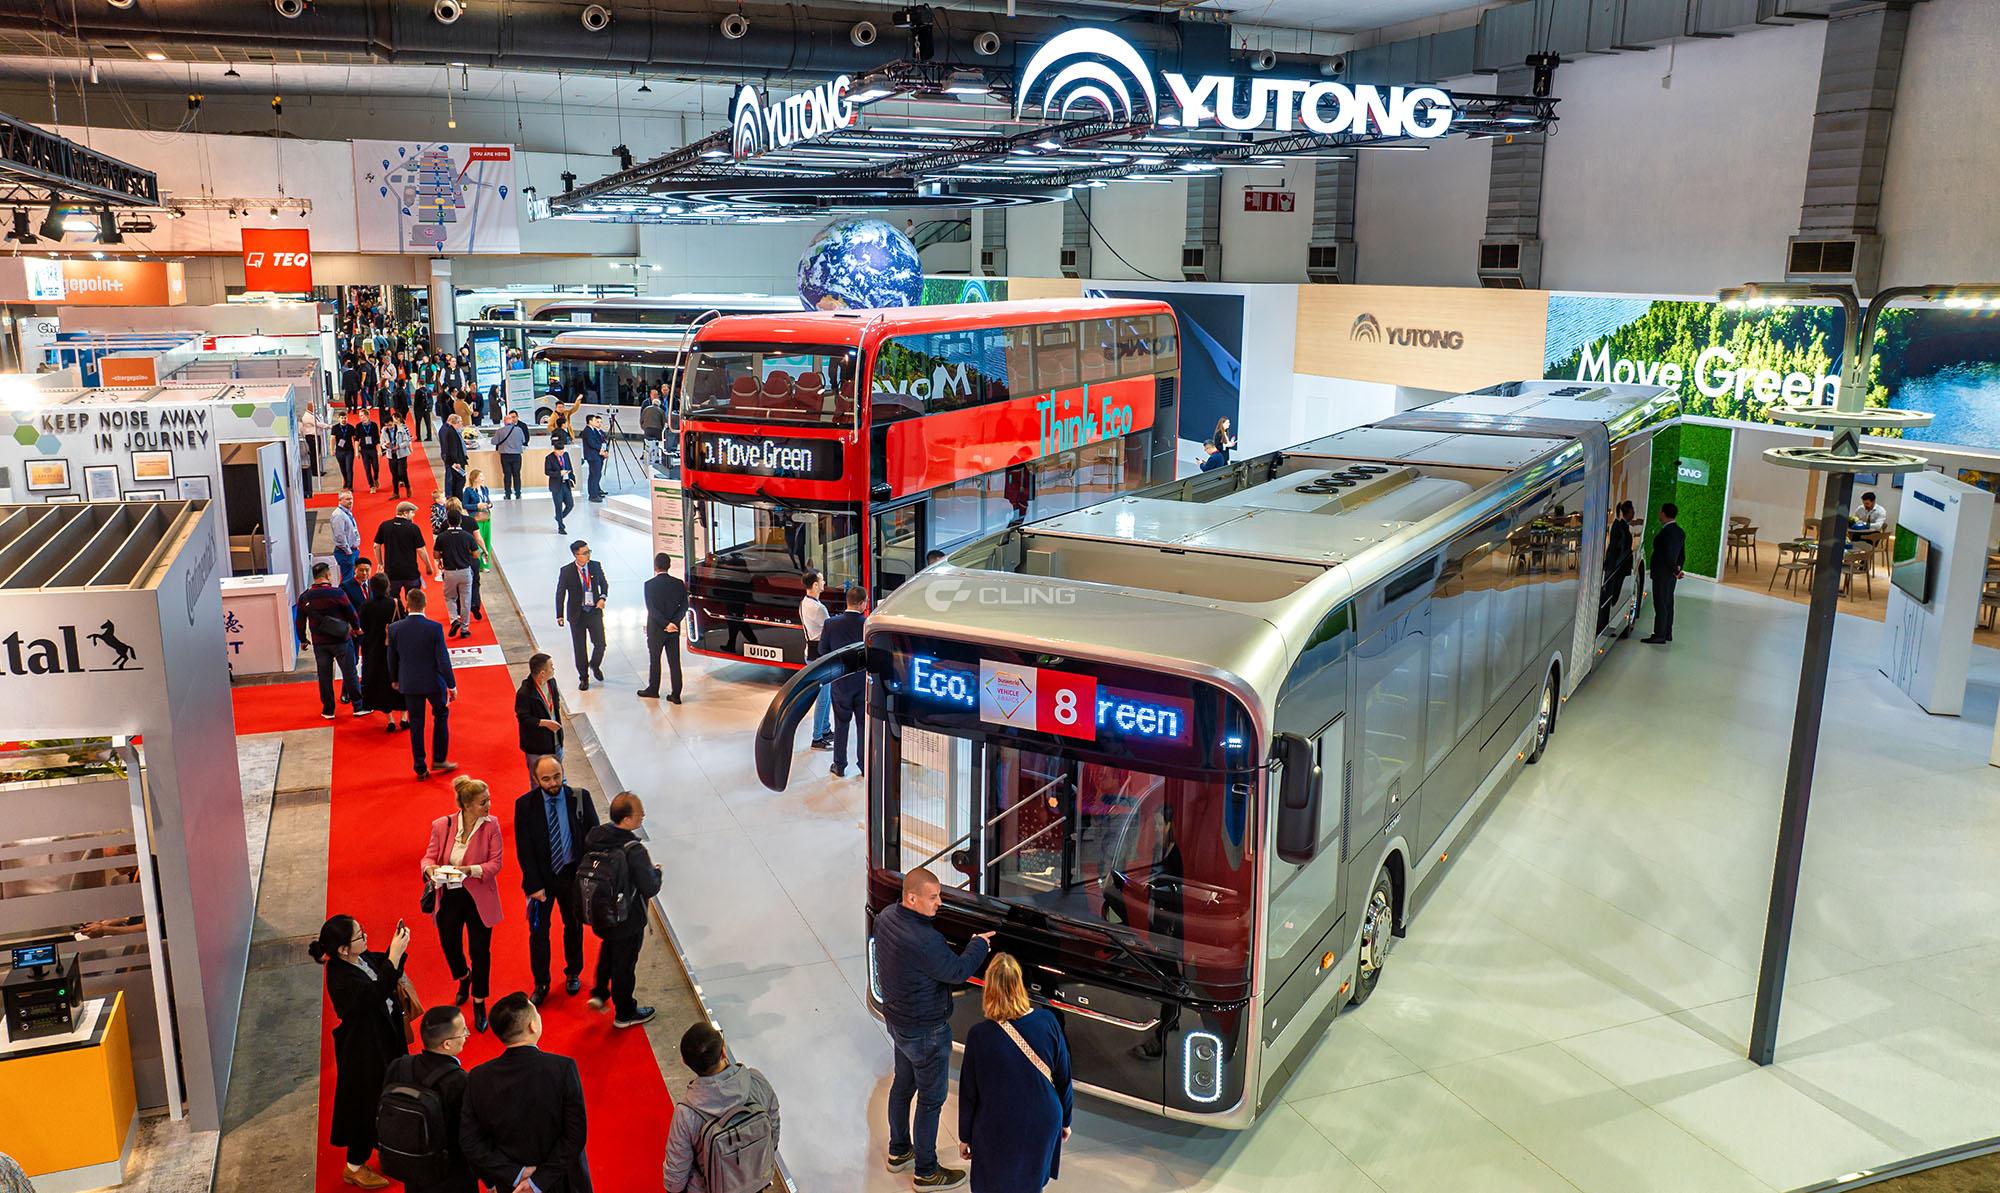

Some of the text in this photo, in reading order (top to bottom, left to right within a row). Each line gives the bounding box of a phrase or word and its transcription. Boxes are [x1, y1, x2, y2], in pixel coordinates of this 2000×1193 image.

[763, 75, 853, 150] YUTONG
[1162, 72, 1455, 139] YUTONG
[273, 252, 309, 267] TEQ
[1386, 326, 1464, 350] YUTONG
[1576, 340, 1841, 407] Move Green
[41, 409, 207, 431] KEEP NOISE AWAY
[1036, 384, 1133, 458] Think Eco
[94, 430, 209, 450] IN JOURNEY
[718, 437, 760, 467] Move
[762, 440, 812, 472] Green
[0, 625, 86, 676] tal
[1054, 688, 1078, 725] 8
[1097, 697, 1178, 737] reen
[1031, 983, 1089, 1005] ONG
